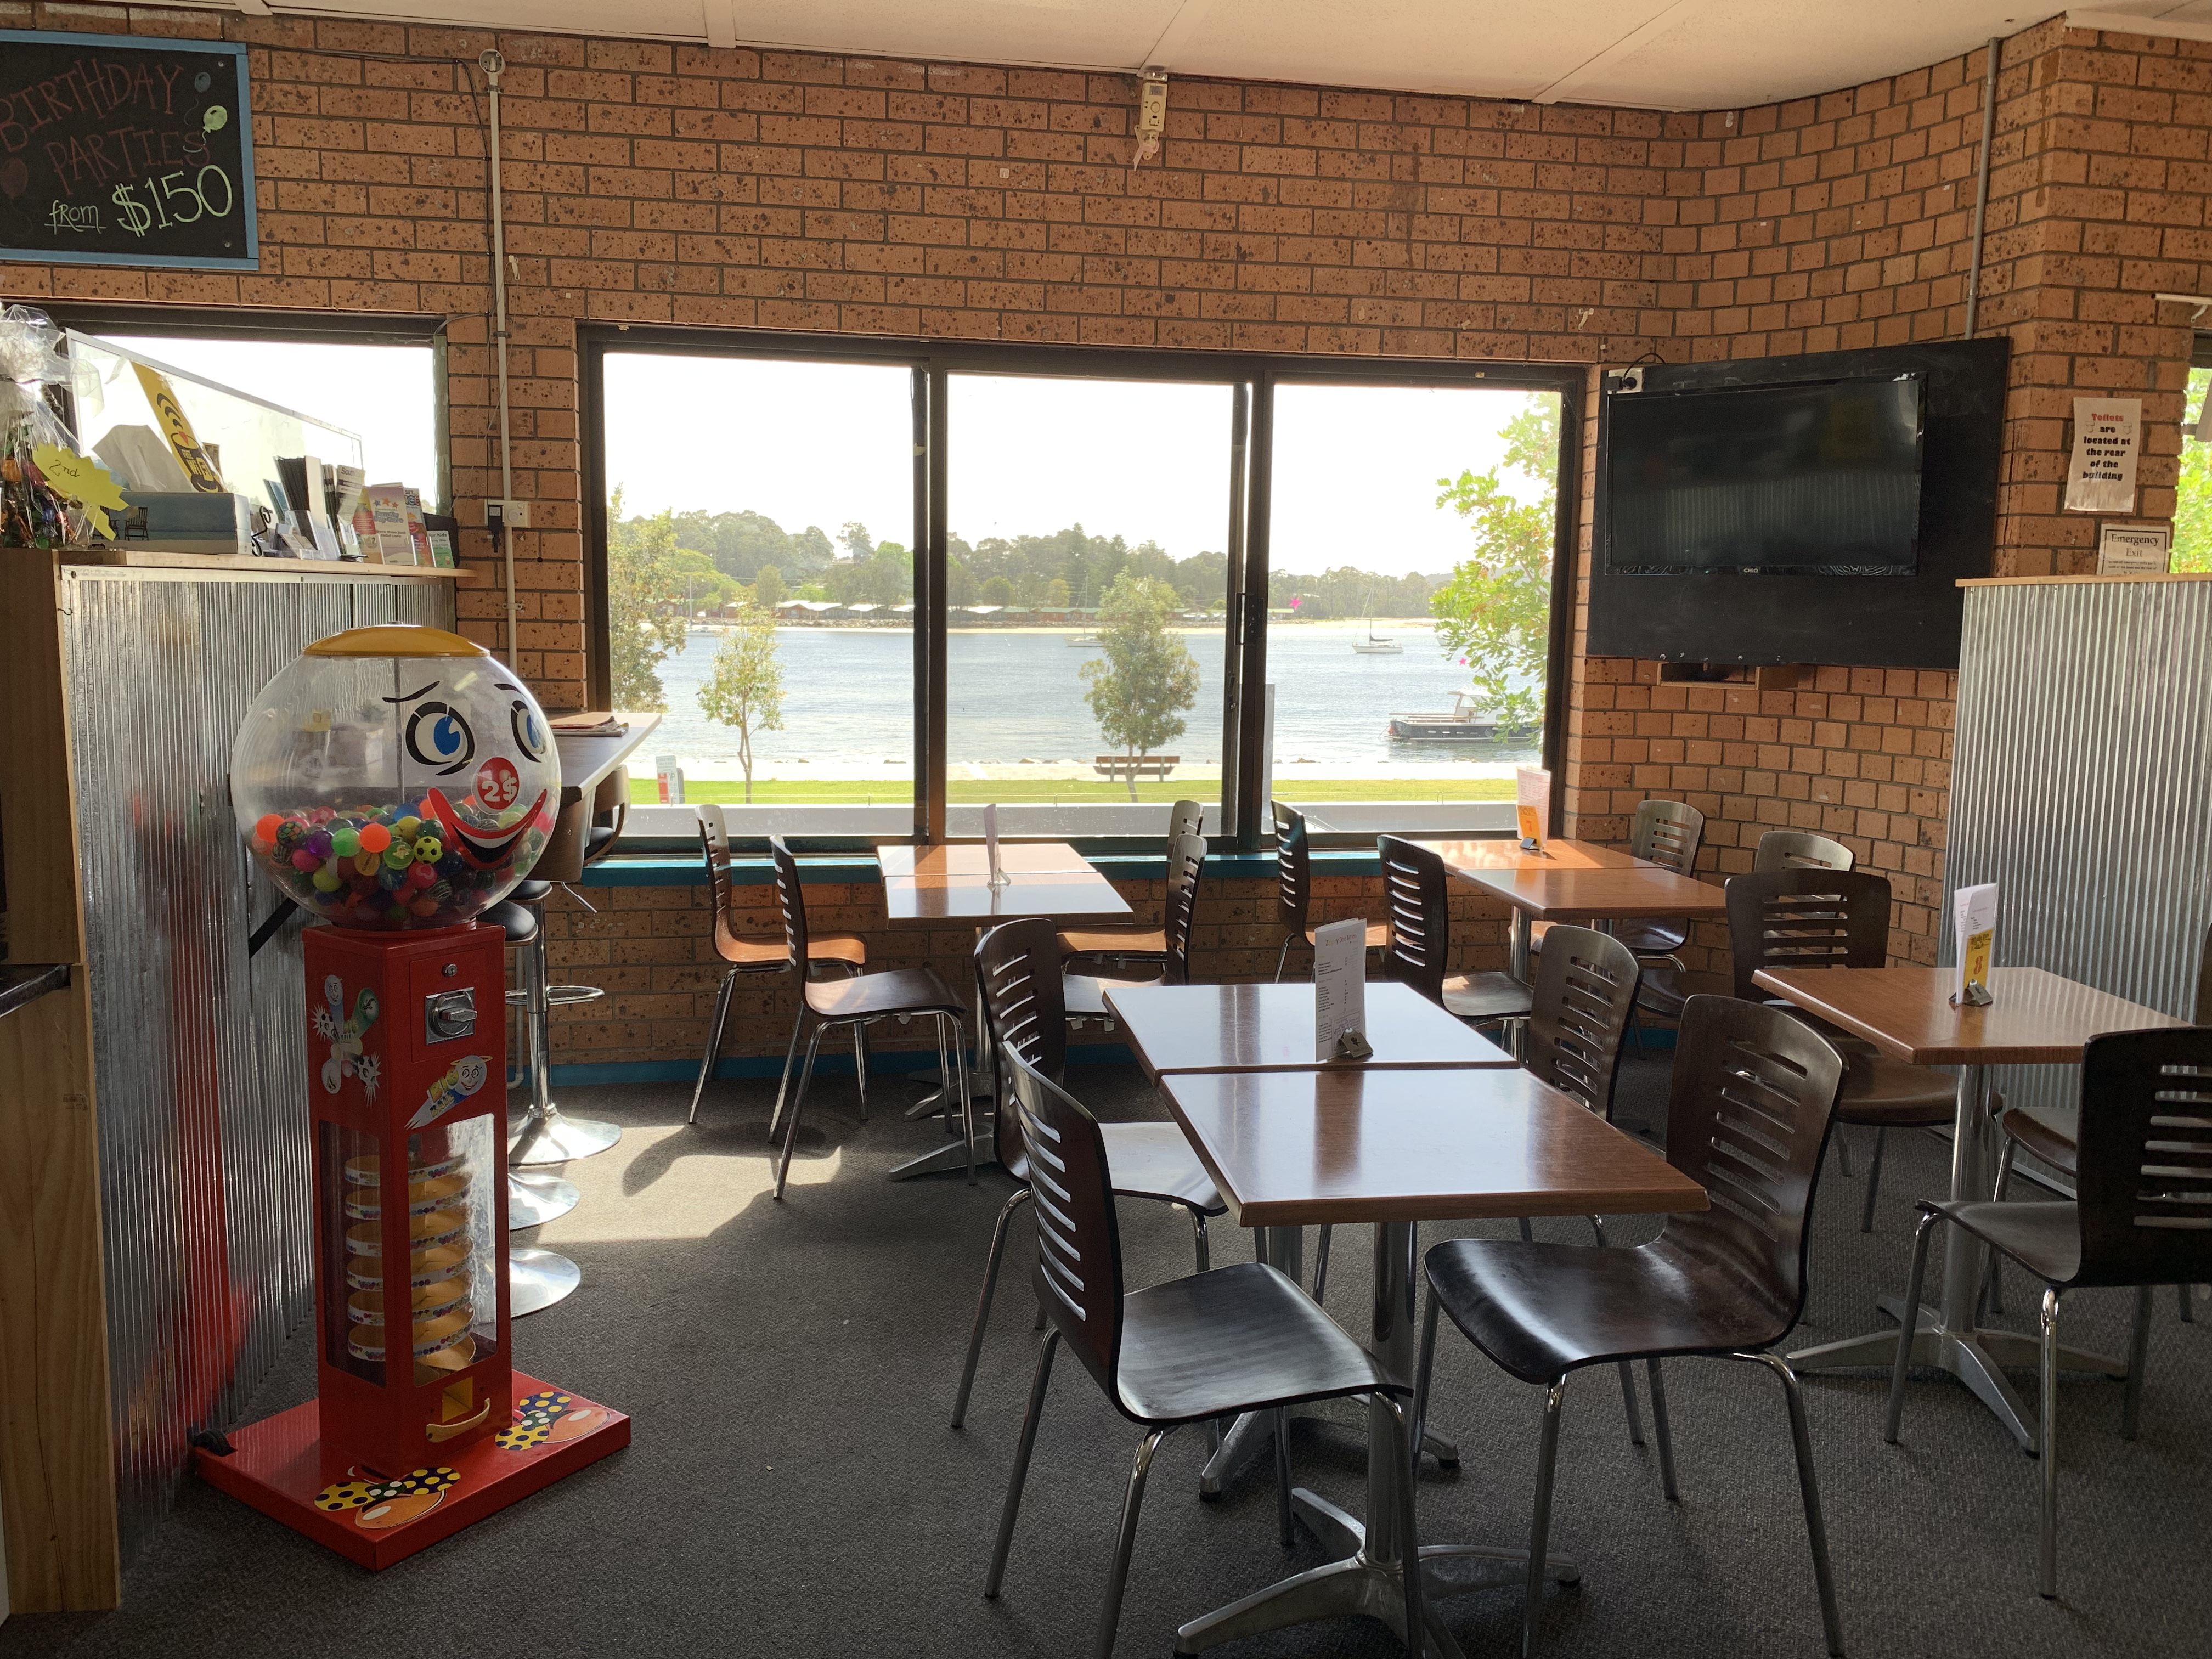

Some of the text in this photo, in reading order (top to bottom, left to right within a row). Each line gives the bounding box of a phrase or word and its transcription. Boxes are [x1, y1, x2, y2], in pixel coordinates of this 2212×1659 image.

[0, 58, 184, 153] BIRTHDAY
[43, 125, 211, 195] PARTIES
[111, 164, 233, 237] $150
[2091, 413, 2124, 422] Toilets
[2083, 436, 2131, 445] located at
[2086, 448, 2126, 457] the rear
[49, 459, 80, 477] 2nd
[2090, 460, 2119, 468] of the
[2082, 471, 2123, 482] building
[2111, 533, 2160, 546] Emergency
[2126, 548, 2142, 557] Exit
[481, 776, 517, 803] 2$
[1973, 956, 1983, 975] 8
[428, 1066, 459, 1103] BIG
